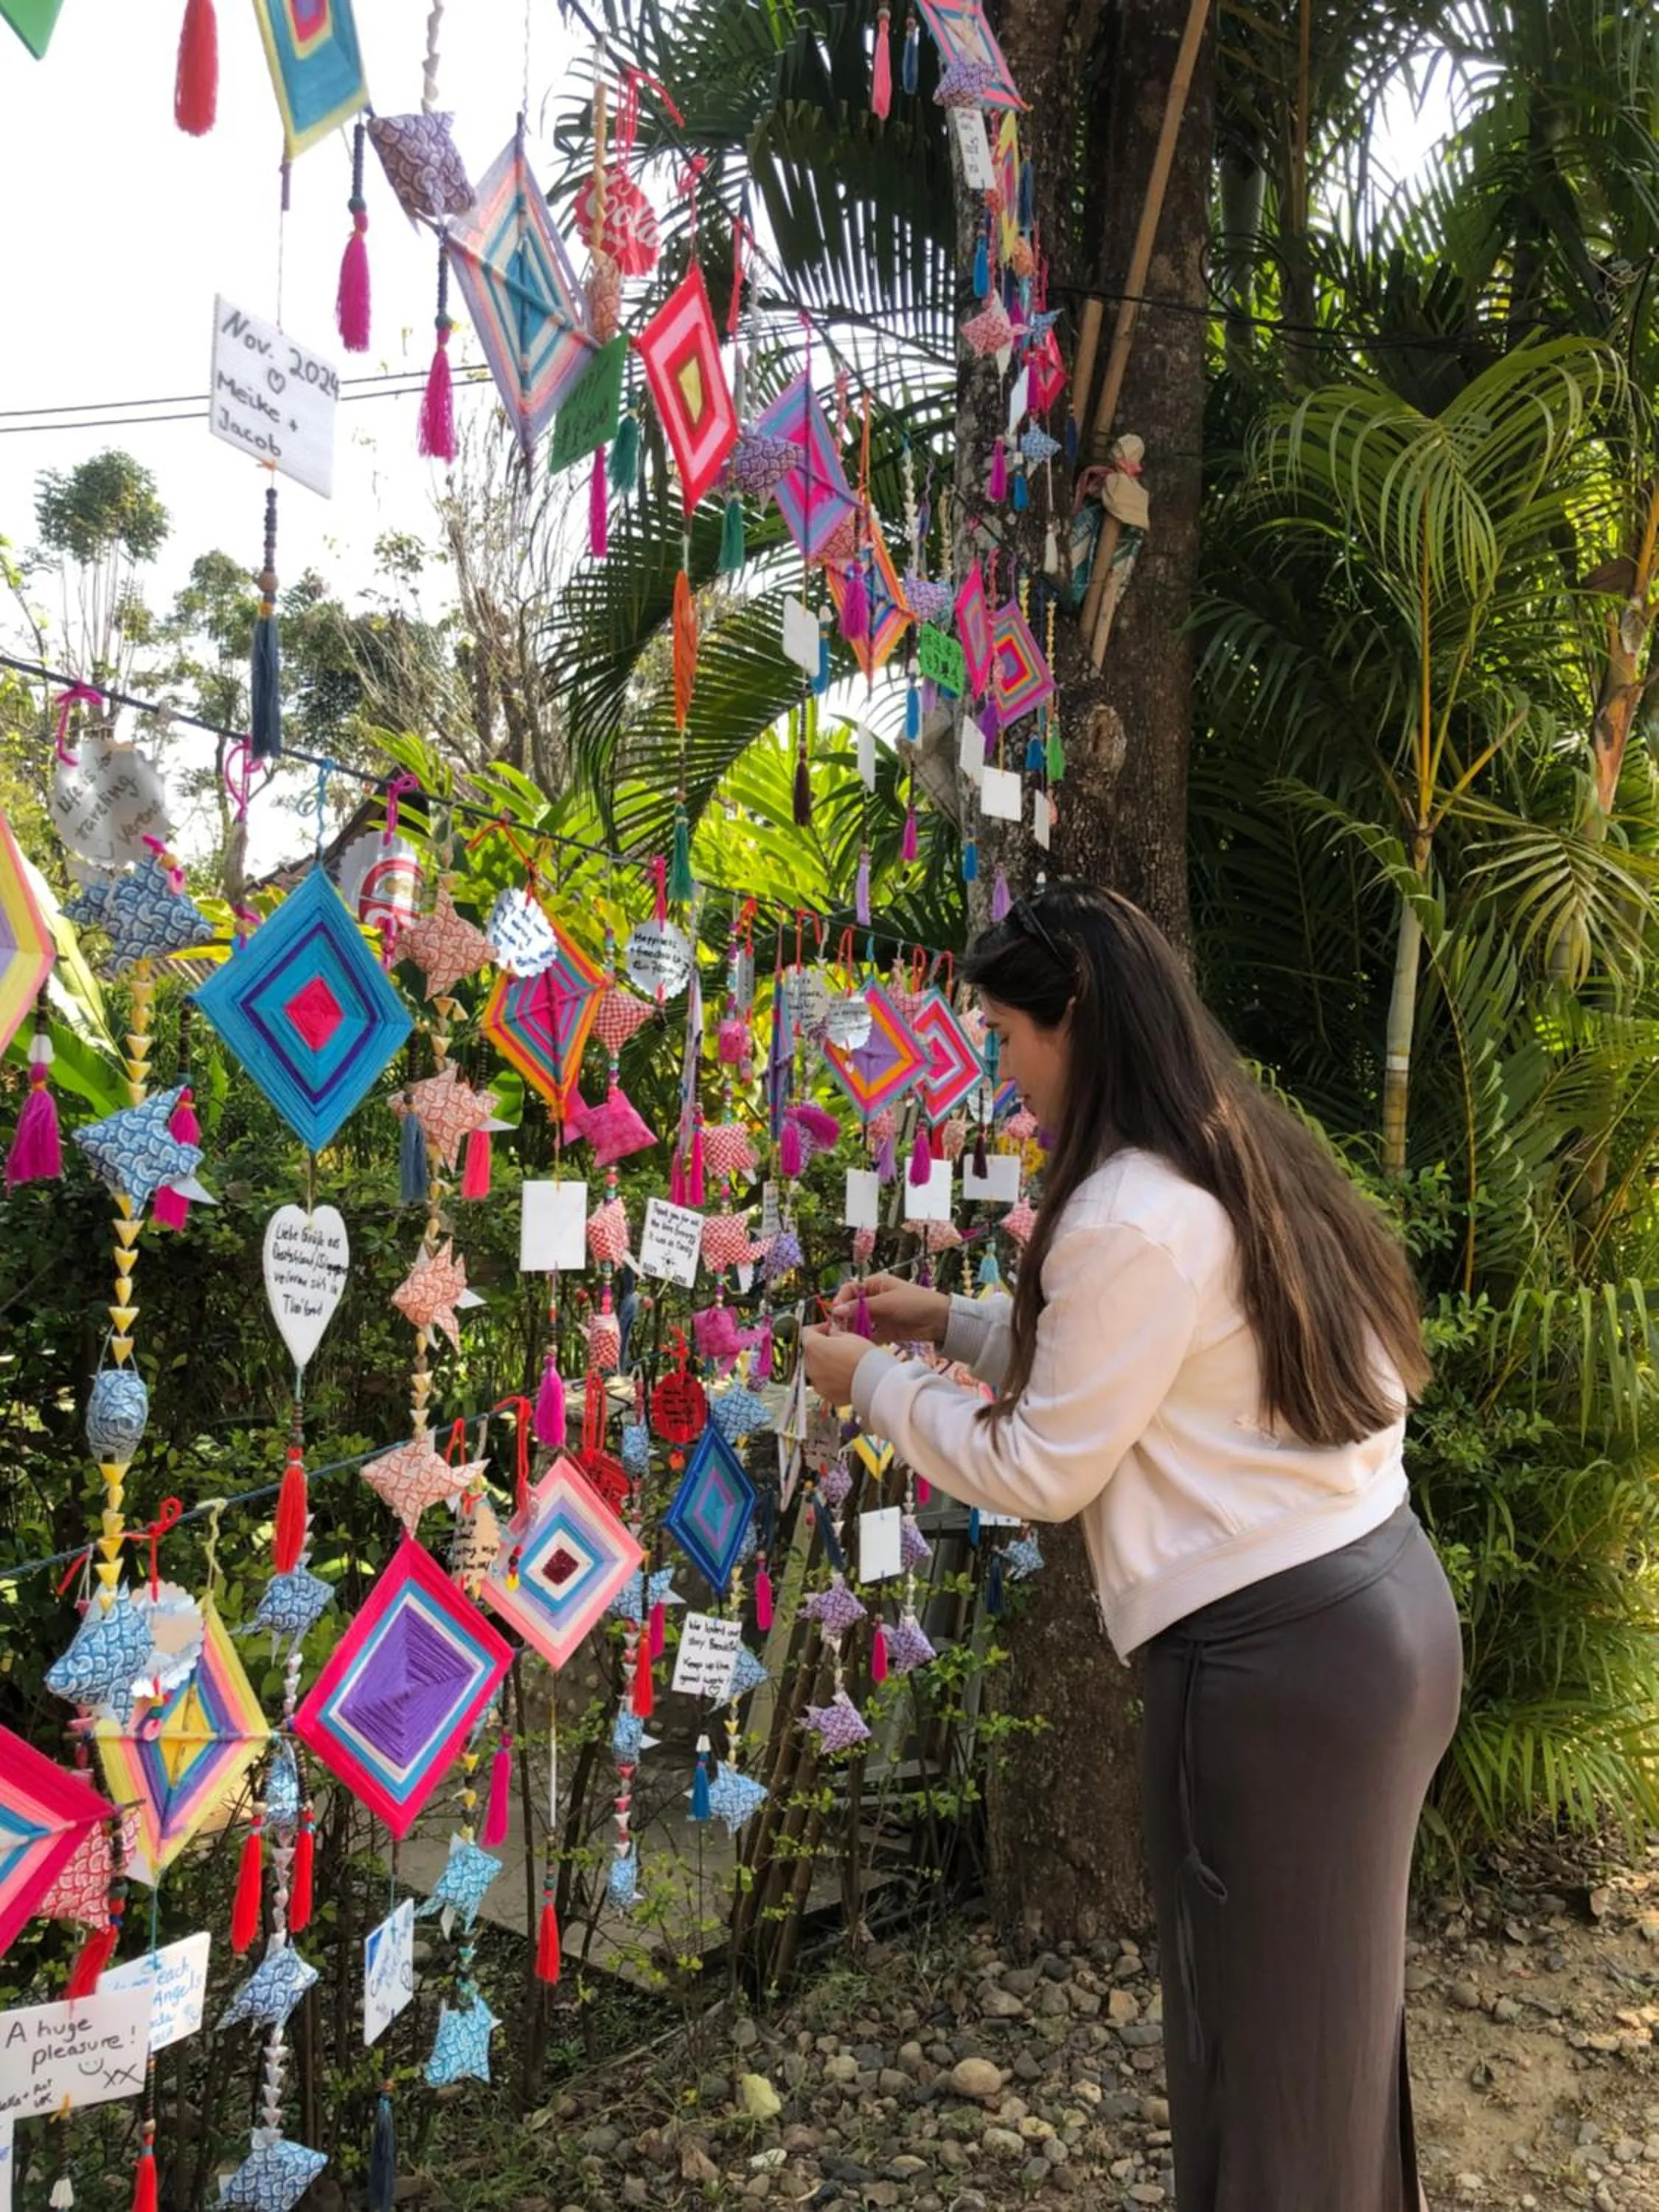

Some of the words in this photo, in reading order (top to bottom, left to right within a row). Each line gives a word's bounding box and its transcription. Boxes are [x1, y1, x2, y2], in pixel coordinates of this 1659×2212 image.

[220, 310, 274, 359] Nov.
[288, 347, 340, 401] 2024
[217, 371, 280, 422] Meike
[218, 407, 281, 457] Jacob
[276, 1224, 298, 1241] Liebe
[6, 2021, 27, 2048] A
[38, 2017, 93, 2042] huge
